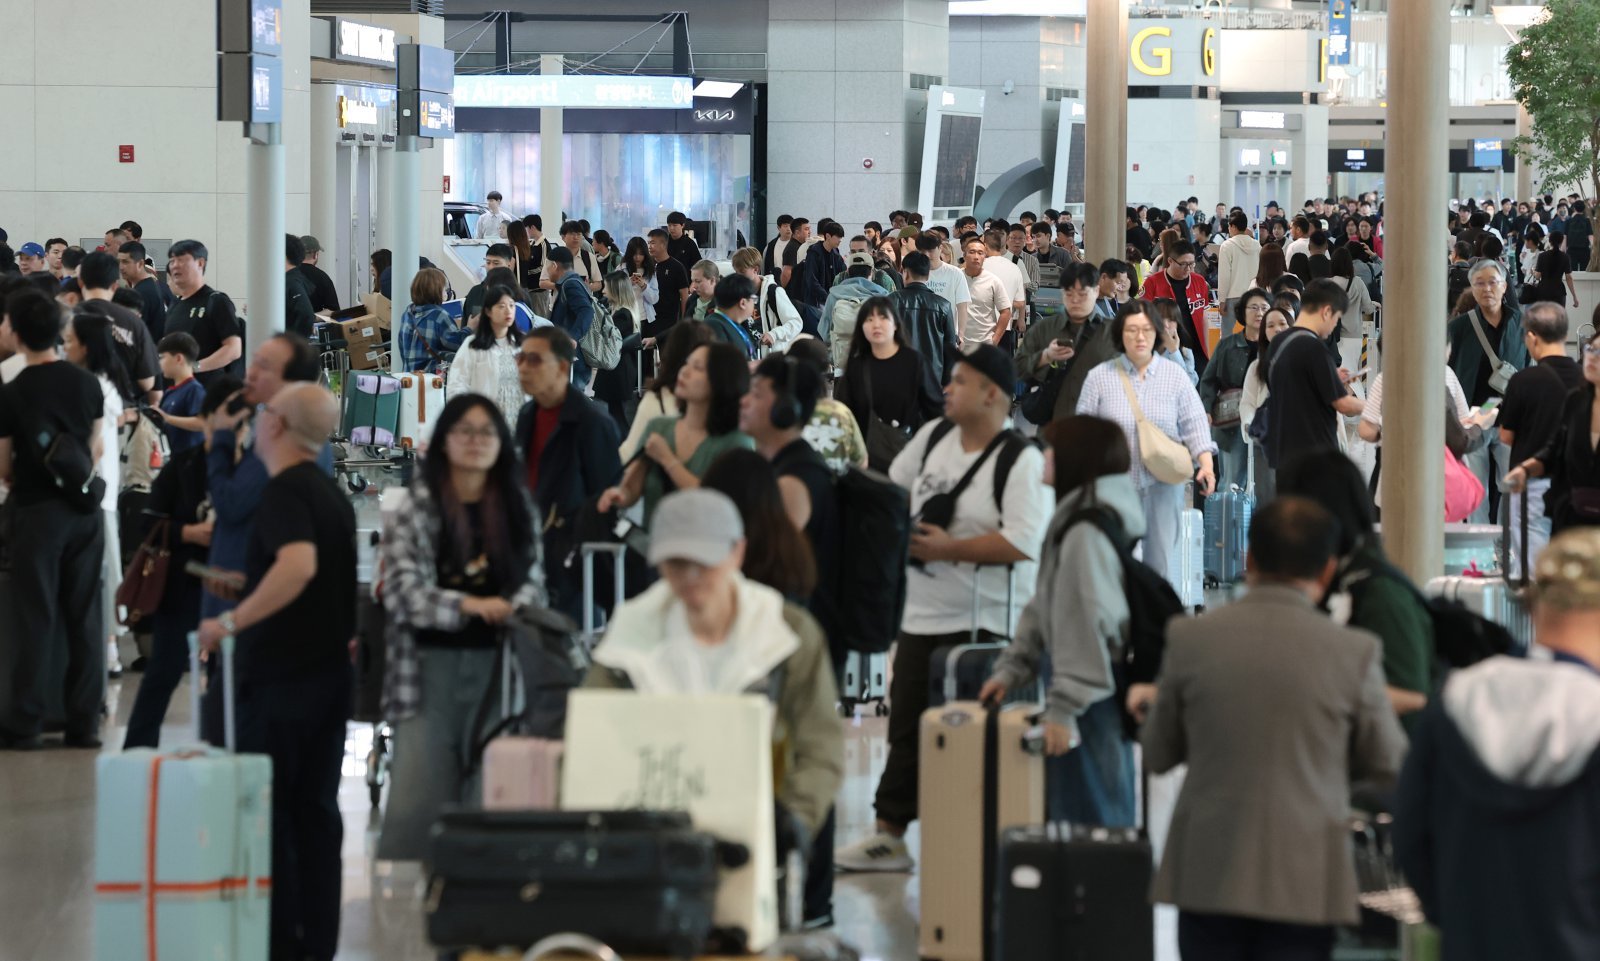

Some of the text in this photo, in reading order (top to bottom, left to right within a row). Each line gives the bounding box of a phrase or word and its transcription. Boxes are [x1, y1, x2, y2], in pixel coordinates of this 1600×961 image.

[1130, 27, 1172, 76] G
[1202, 28, 1215, 76] G
[472, 80, 558, 107] Airport!
[694, 109, 734, 121] KIA
